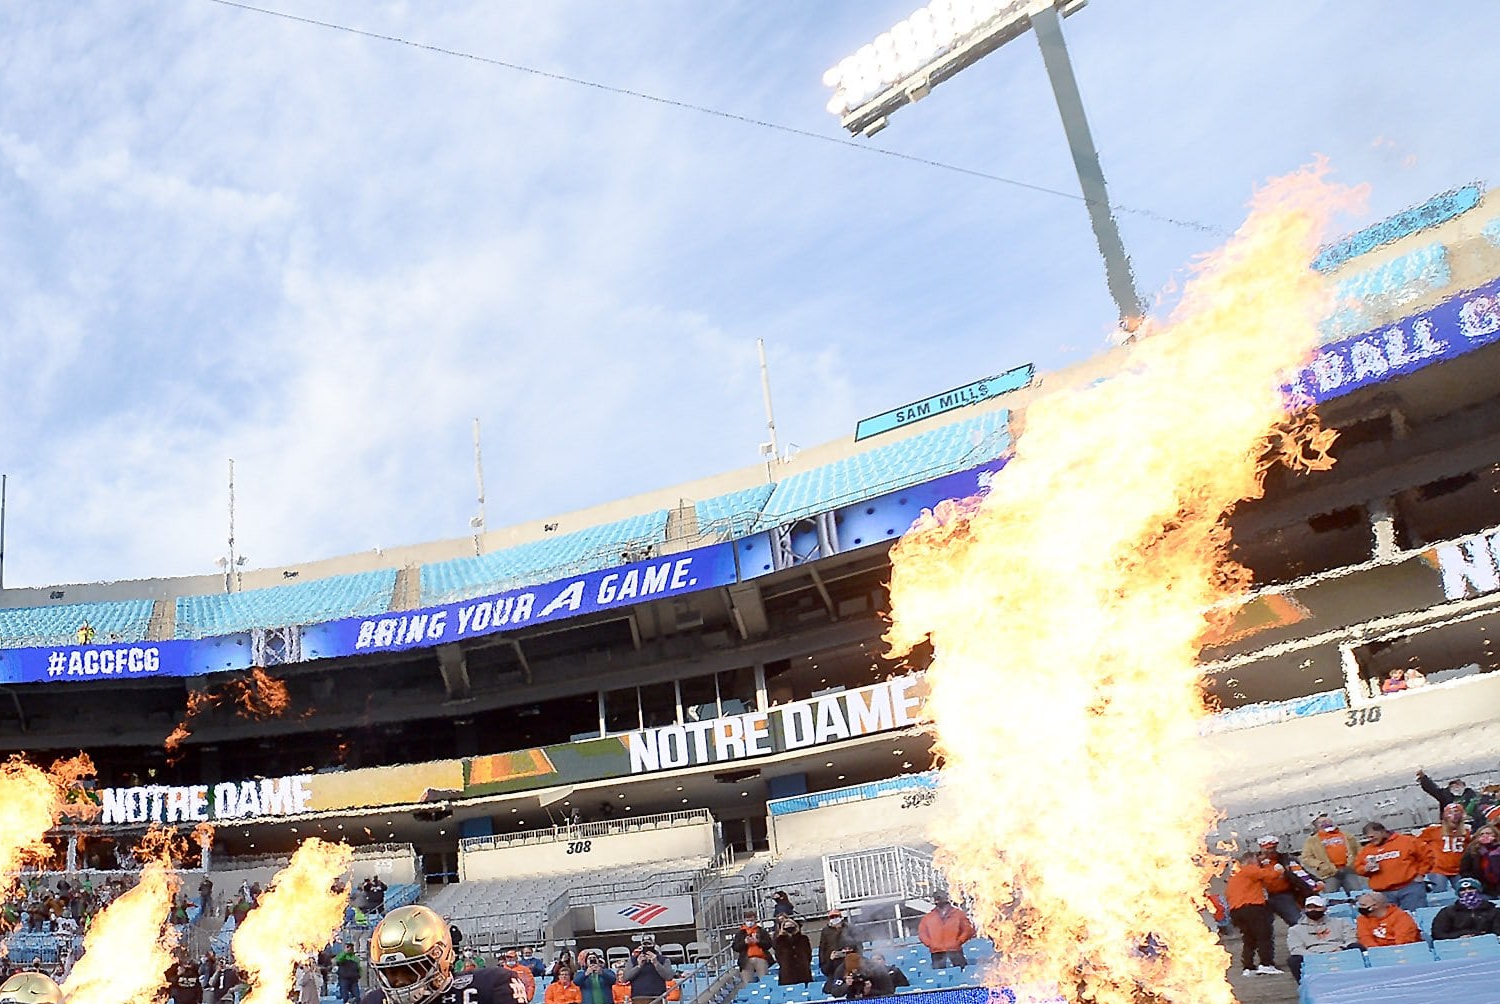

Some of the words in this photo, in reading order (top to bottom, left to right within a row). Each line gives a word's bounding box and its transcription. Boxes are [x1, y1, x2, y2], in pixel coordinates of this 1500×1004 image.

[896, 402, 931, 423] SAM
[939, 384, 989, 410] MILLS
[355, 611, 447, 650] BRING
[456, 592, 536, 635] YOUR
[537, 580, 586, 618] A
[596, 557, 698, 605] GAME.
[629, 711, 773, 774] NOTRE
[781, 676, 922, 751] DAME
[1344, 706, 1382, 728] 310
[101, 783, 209, 824] NOTRE
[213, 773, 312, 821] DAME
[565, 840, 592, 856] 308
